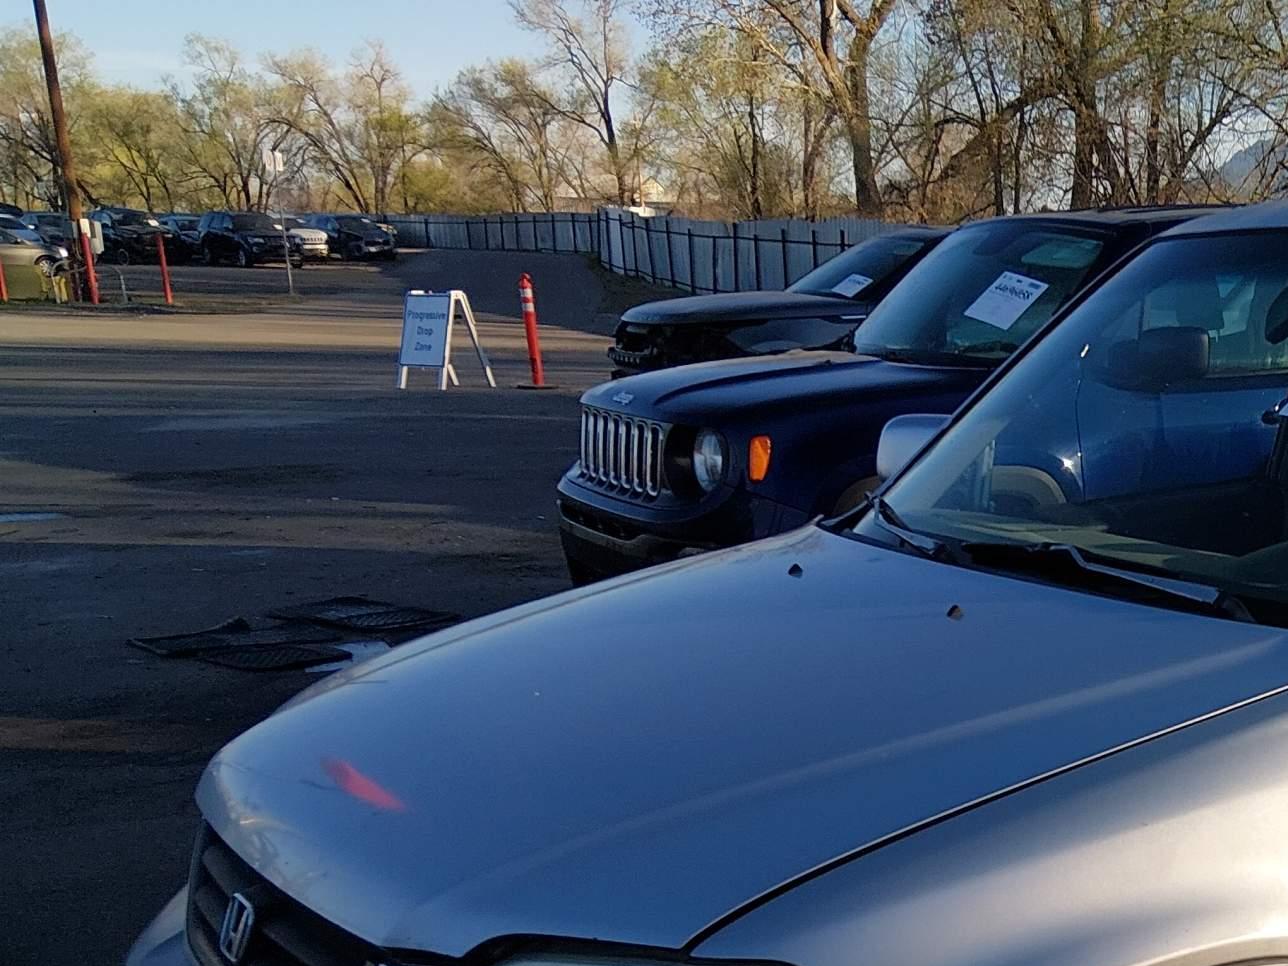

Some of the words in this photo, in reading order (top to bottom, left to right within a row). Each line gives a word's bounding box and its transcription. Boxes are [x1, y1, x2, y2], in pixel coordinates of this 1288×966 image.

[407, 310, 446, 321] Progressive
[416, 326, 434, 337] Drop
[414, 342, 432, 352] Zone
